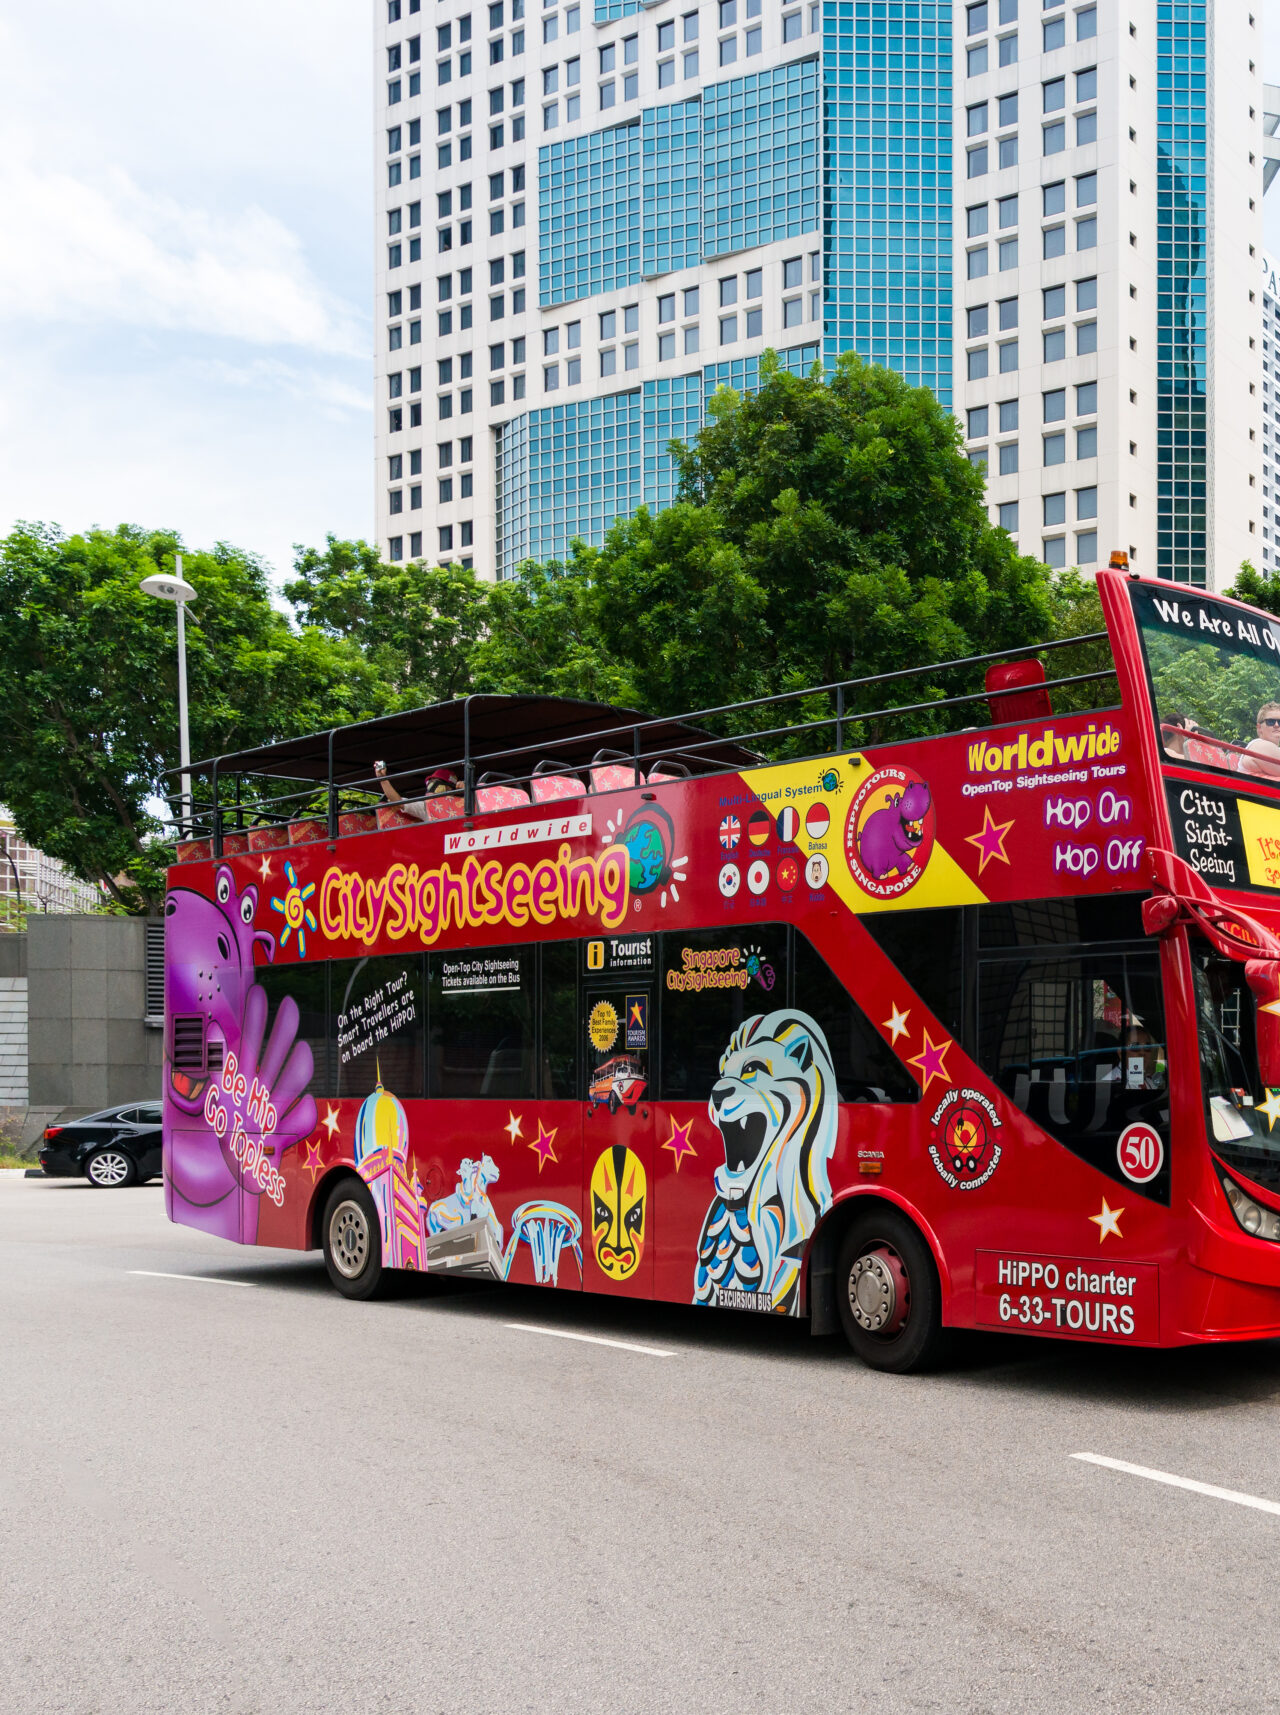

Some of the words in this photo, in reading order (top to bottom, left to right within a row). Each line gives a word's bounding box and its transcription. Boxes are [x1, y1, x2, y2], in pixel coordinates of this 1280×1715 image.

[1153, 599, 1193, 627] We
[1199, 609, 1233, 637] Are
[1237, 619, 1261, 646] All
[968, 724, 1120, 772] Worldwide
[719, 789, 782, 807] Multi-Lingual
[784, 784, 822, 798] System
[962, 779, 1013, 796] OpenTop
[1016, 769, 1088, 789] Sightseeing
[1091, 765, 1126, 778] Tours
[847, 768, 906, 848] HIPPOTOURS
[1046, 798, 1091, 829] Hop
[1099, 791, 1129, 823] On
[1180, 789, 1226, 825] City
[449, 820, 588, 850] Worldwide
[808, 842, 828, 851] Bahasa
[1185, 820, 1233, 851] Sight-
[1055, 844, 1098, 876] Hop
[1107, 839, 1143, 871] Off
[1190, 849, 1235, 882] Seeing
[850, 858, 921, 895] SINGAPORE
[1265, 867, 1280, 884] Go
[320, 842, 630, 946] CitySightseeing
[610, 938, 651, 957] Tourist
[610, 957, 651, 967] information
[682, 947, 741, 971] Singapore
[442, 976, 462, 987] Tickets
[463, 975, 488, 985] available
[497, 974, 507, 983] the
[508, 972, 520, 983] Bus
[443, 962, 470, 975] Open-Top
[471, 961, 483, 974] City
[484, 958, 519, 972] Sightseeing
[667, 968, 748, 992] CitySightseeing
[337, 1014, 348, 1028] On
[350, 1006, 362, 1019] the
[364, 989, 384, 1011] Right
[386, 971, 408, 994] Tour?
[597, 1010, 605, 1018] Top
[606, 1010, 611, 1018] 10
[337, 1025, 359, 1048] Smart
[361, 1001, 399, 1032] Travellers
[401, 989, 415, 1004] are
[592, 1026, 616, 1034] Experiences
[602, 1018, 616, 1027] Family
[341, 1050, 350, 1063] on
[352, 1034, 373, 1057] board
[375, 1025, 389, 1042] the
[222, 1051, 247, 1106] Be
[247, 1077, 277, 1139] Hip
[930, 1089, 959, 1125] locally
[961, 1088, 1002, 1127] operated
[204, 1084, 228, 1138] Go
[229, 1111, 286, 1207] Topless
[857, 1150, 885, 1159] SCANIA
[1125, 1136, 1155, 1170] 50
[928, 1144, 959, 1188] globally
[960, 1144, 1002, 1190] connected
[1065, 1266, 1137, 1296] charter
[720, 1289, 757, 1310] EXCURSION
[758, 1293, 772, 1311] BUS
[999, 1293, 1135, 1335] 6-33-TOURS
